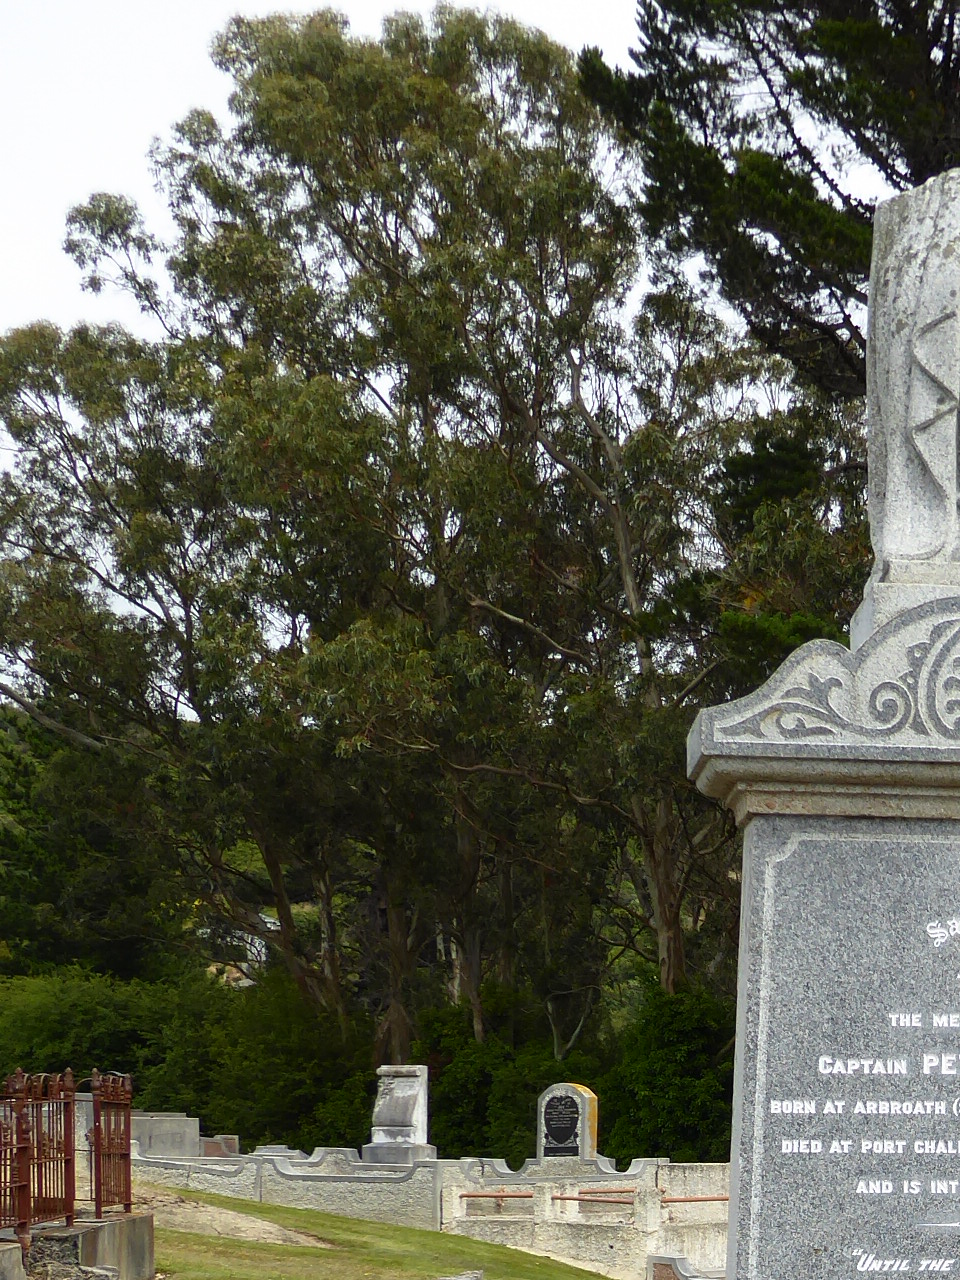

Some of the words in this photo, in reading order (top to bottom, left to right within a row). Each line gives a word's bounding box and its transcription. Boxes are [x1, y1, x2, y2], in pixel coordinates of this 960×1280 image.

[889, 1013, 921, 1027] THE
[818, 1055, 907, 1074] CAPTAIN
[771, 1100, 816, 1114] BORN
[823, 1100, 845, 1114] AT
[854, 1100, 946, 1115] ARBROATH
[782, 1140, 822, 1154] DIED
[829, 1140, 853, 1154] AT
[861, 1140, 907, 1154] PORT
[856, 1180, 893, 1194] AND
[903, 1180, 921, 1194] IS
[919, 1259, 955, 1271] THE
